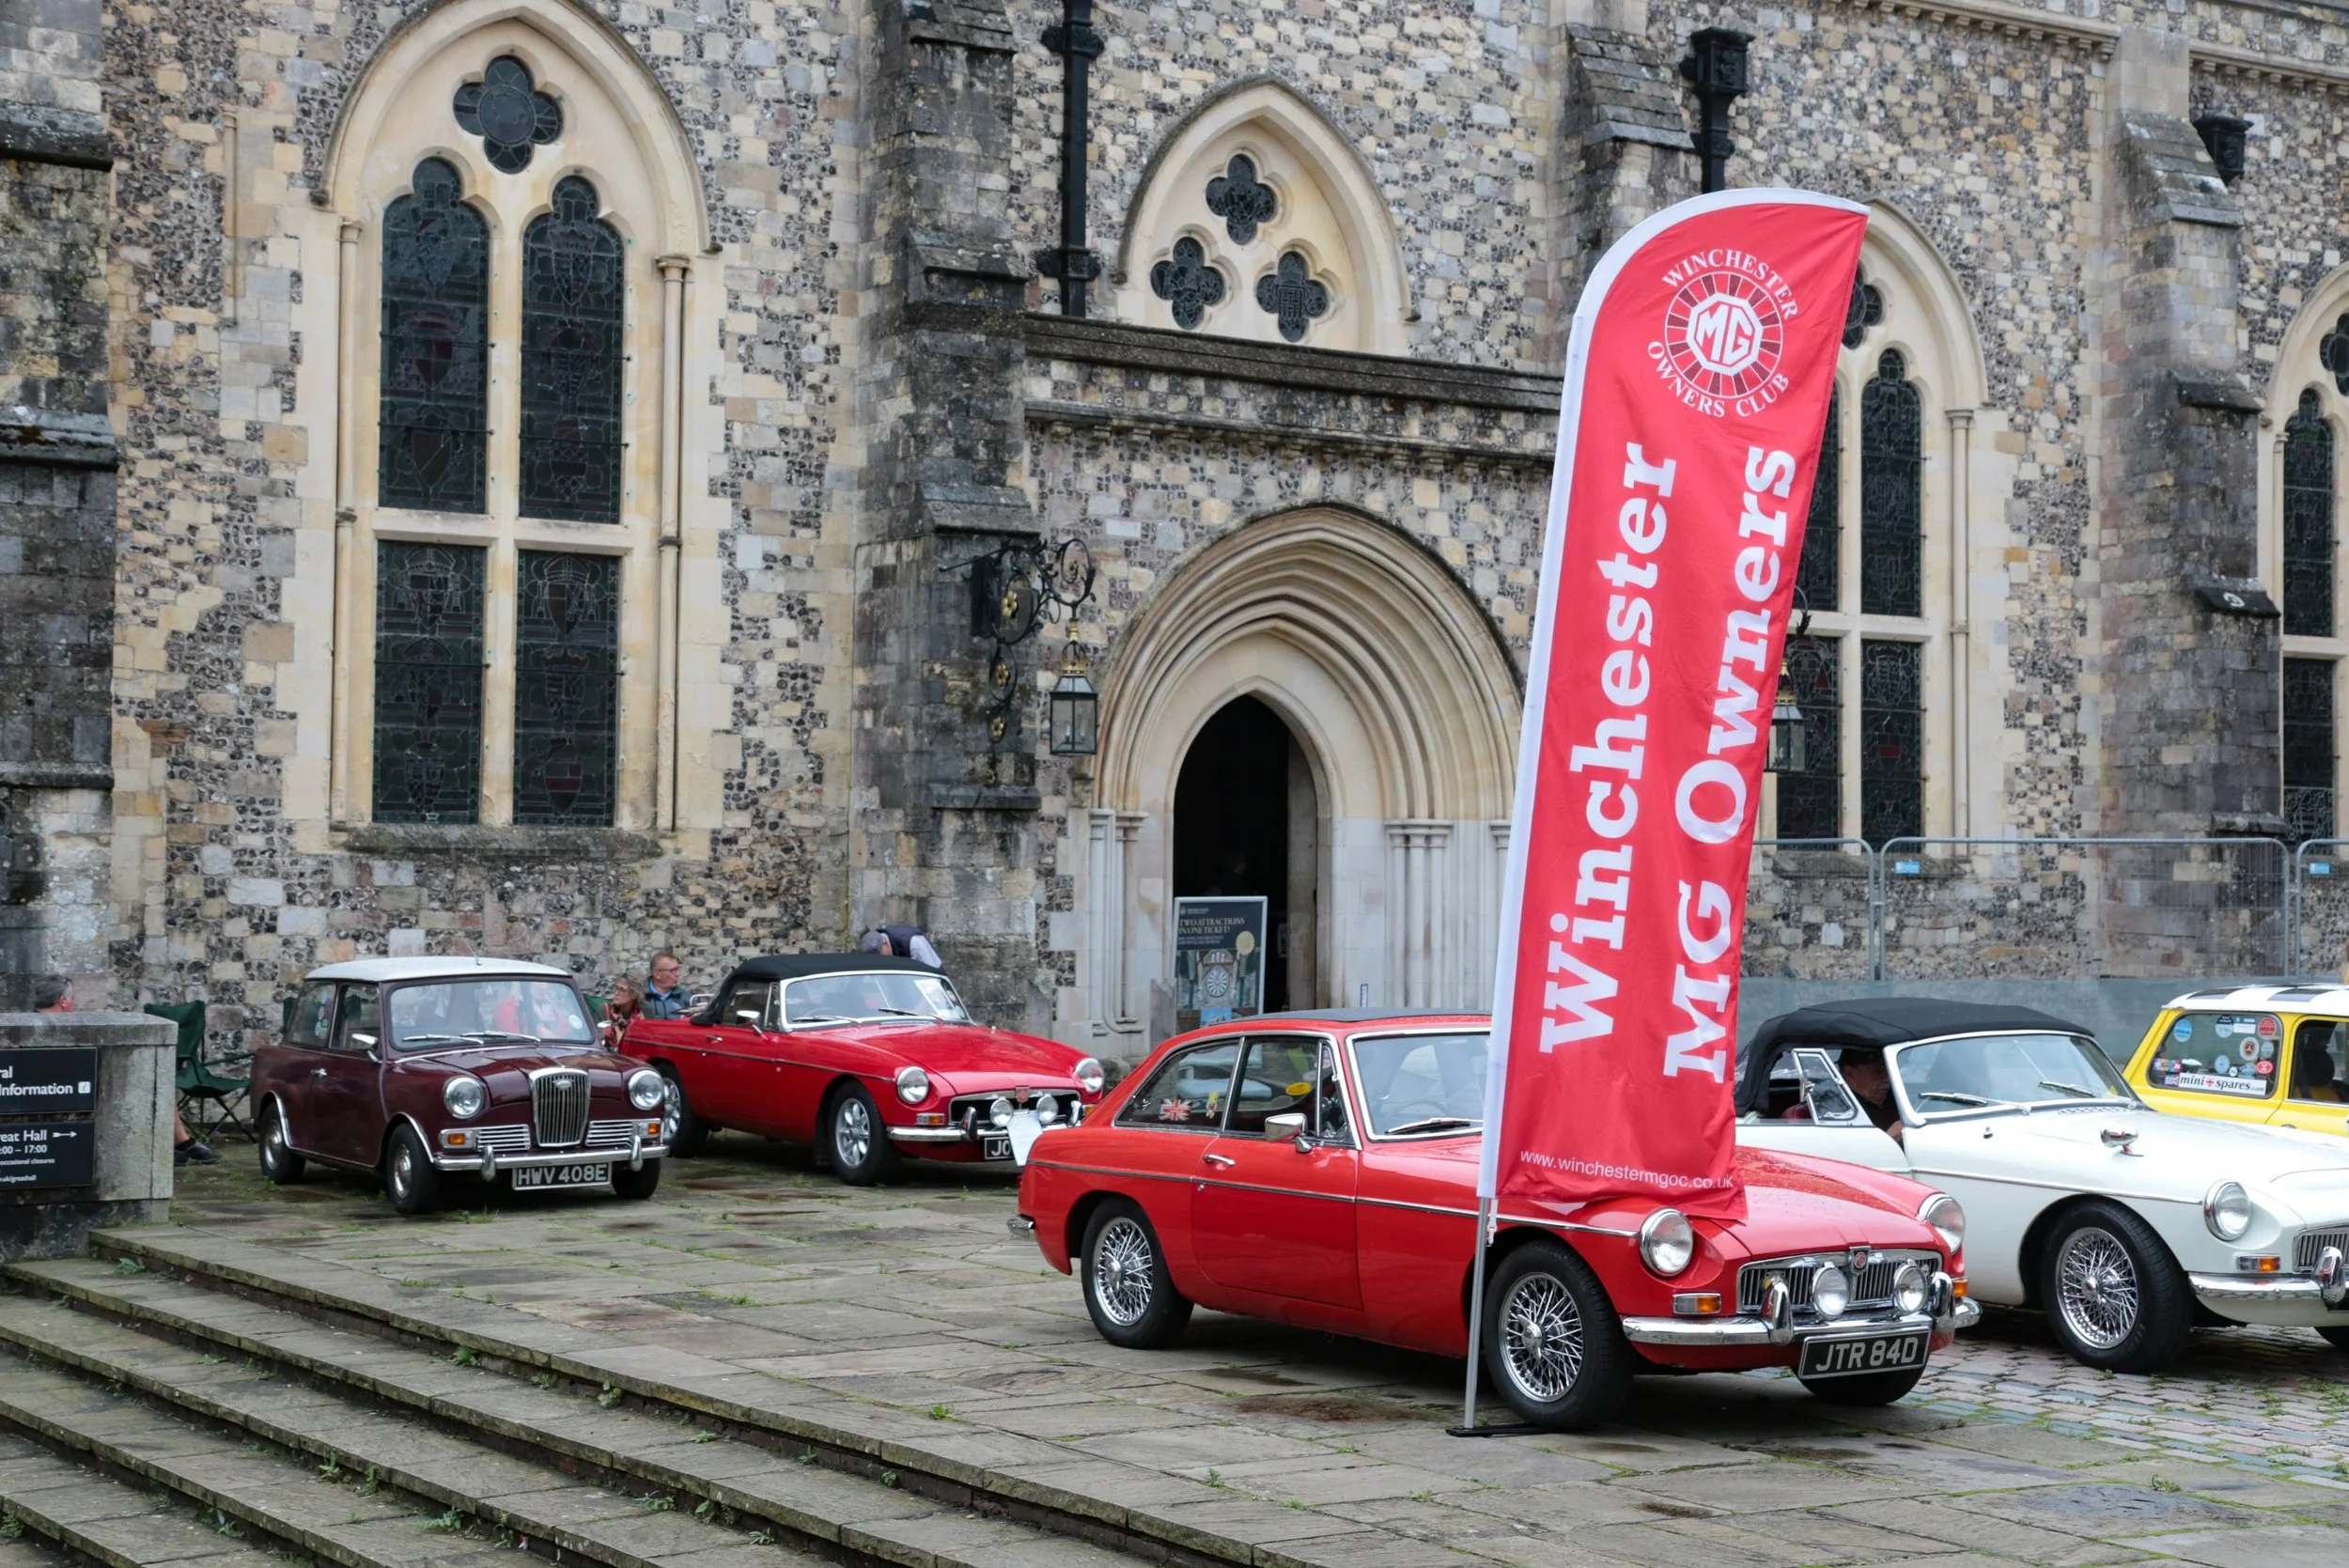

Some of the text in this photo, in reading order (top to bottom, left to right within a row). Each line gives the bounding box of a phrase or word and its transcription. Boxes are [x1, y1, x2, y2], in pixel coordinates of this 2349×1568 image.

[1662, 249, 1798, 320] WINCHESTER
[1695, 303, 1754, 366] MG
[1648, 341, 1790, 417] OWNERS CLUB
[1539, 442, 1677, 1054] Winchester
[1663, 445, 1797, 1083] MG Owners
[1179, 917, 1246, 927] TWO ATTRACTIONS
[1187, 926, 1204, 935] ONE
[0, 1082, 74, 1096] Information
[2180, 1074, 2205, 1086] mini
[0, 1129, 48, 1142] eat Hall
[24, 1144, 48, 1154] 17:00
[518, 1164, 608, 1186] HWV 408E
[1519, 1150, 1735, 1189] www.winchestermgoc.co.uk
[1815, 1337, 1920, 1372] JTR 84D
